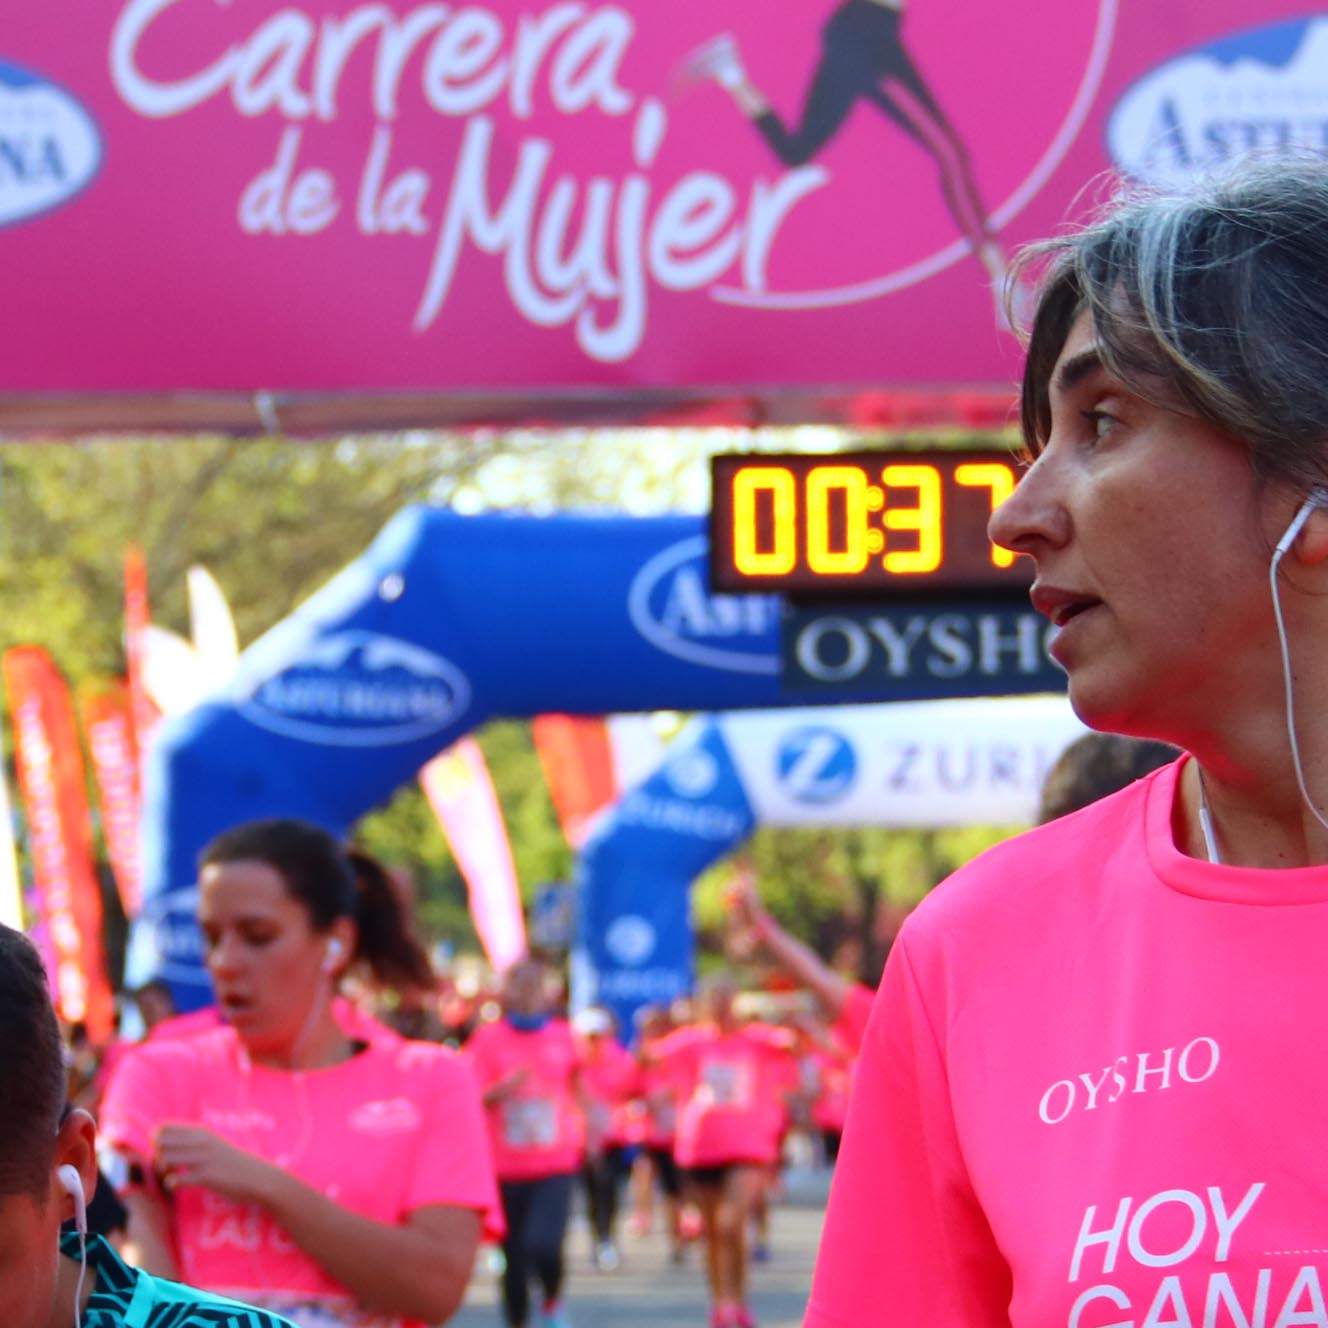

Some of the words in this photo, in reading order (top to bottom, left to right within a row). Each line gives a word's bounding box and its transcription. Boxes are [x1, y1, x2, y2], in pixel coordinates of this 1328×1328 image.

[110, 0, 635, 122] Carrera
[239, 124, 340, 236] de
[358, 122, 431, 236] la
[413, 100, 830, 363] Mujer
[731, 463, 1016, 577] 00:37
[795, 613, 1069, 682] OYSH
[1038, 1036, 1221, 1126] OYSHO
[1067, 1182, 1267, 1283] HOY
